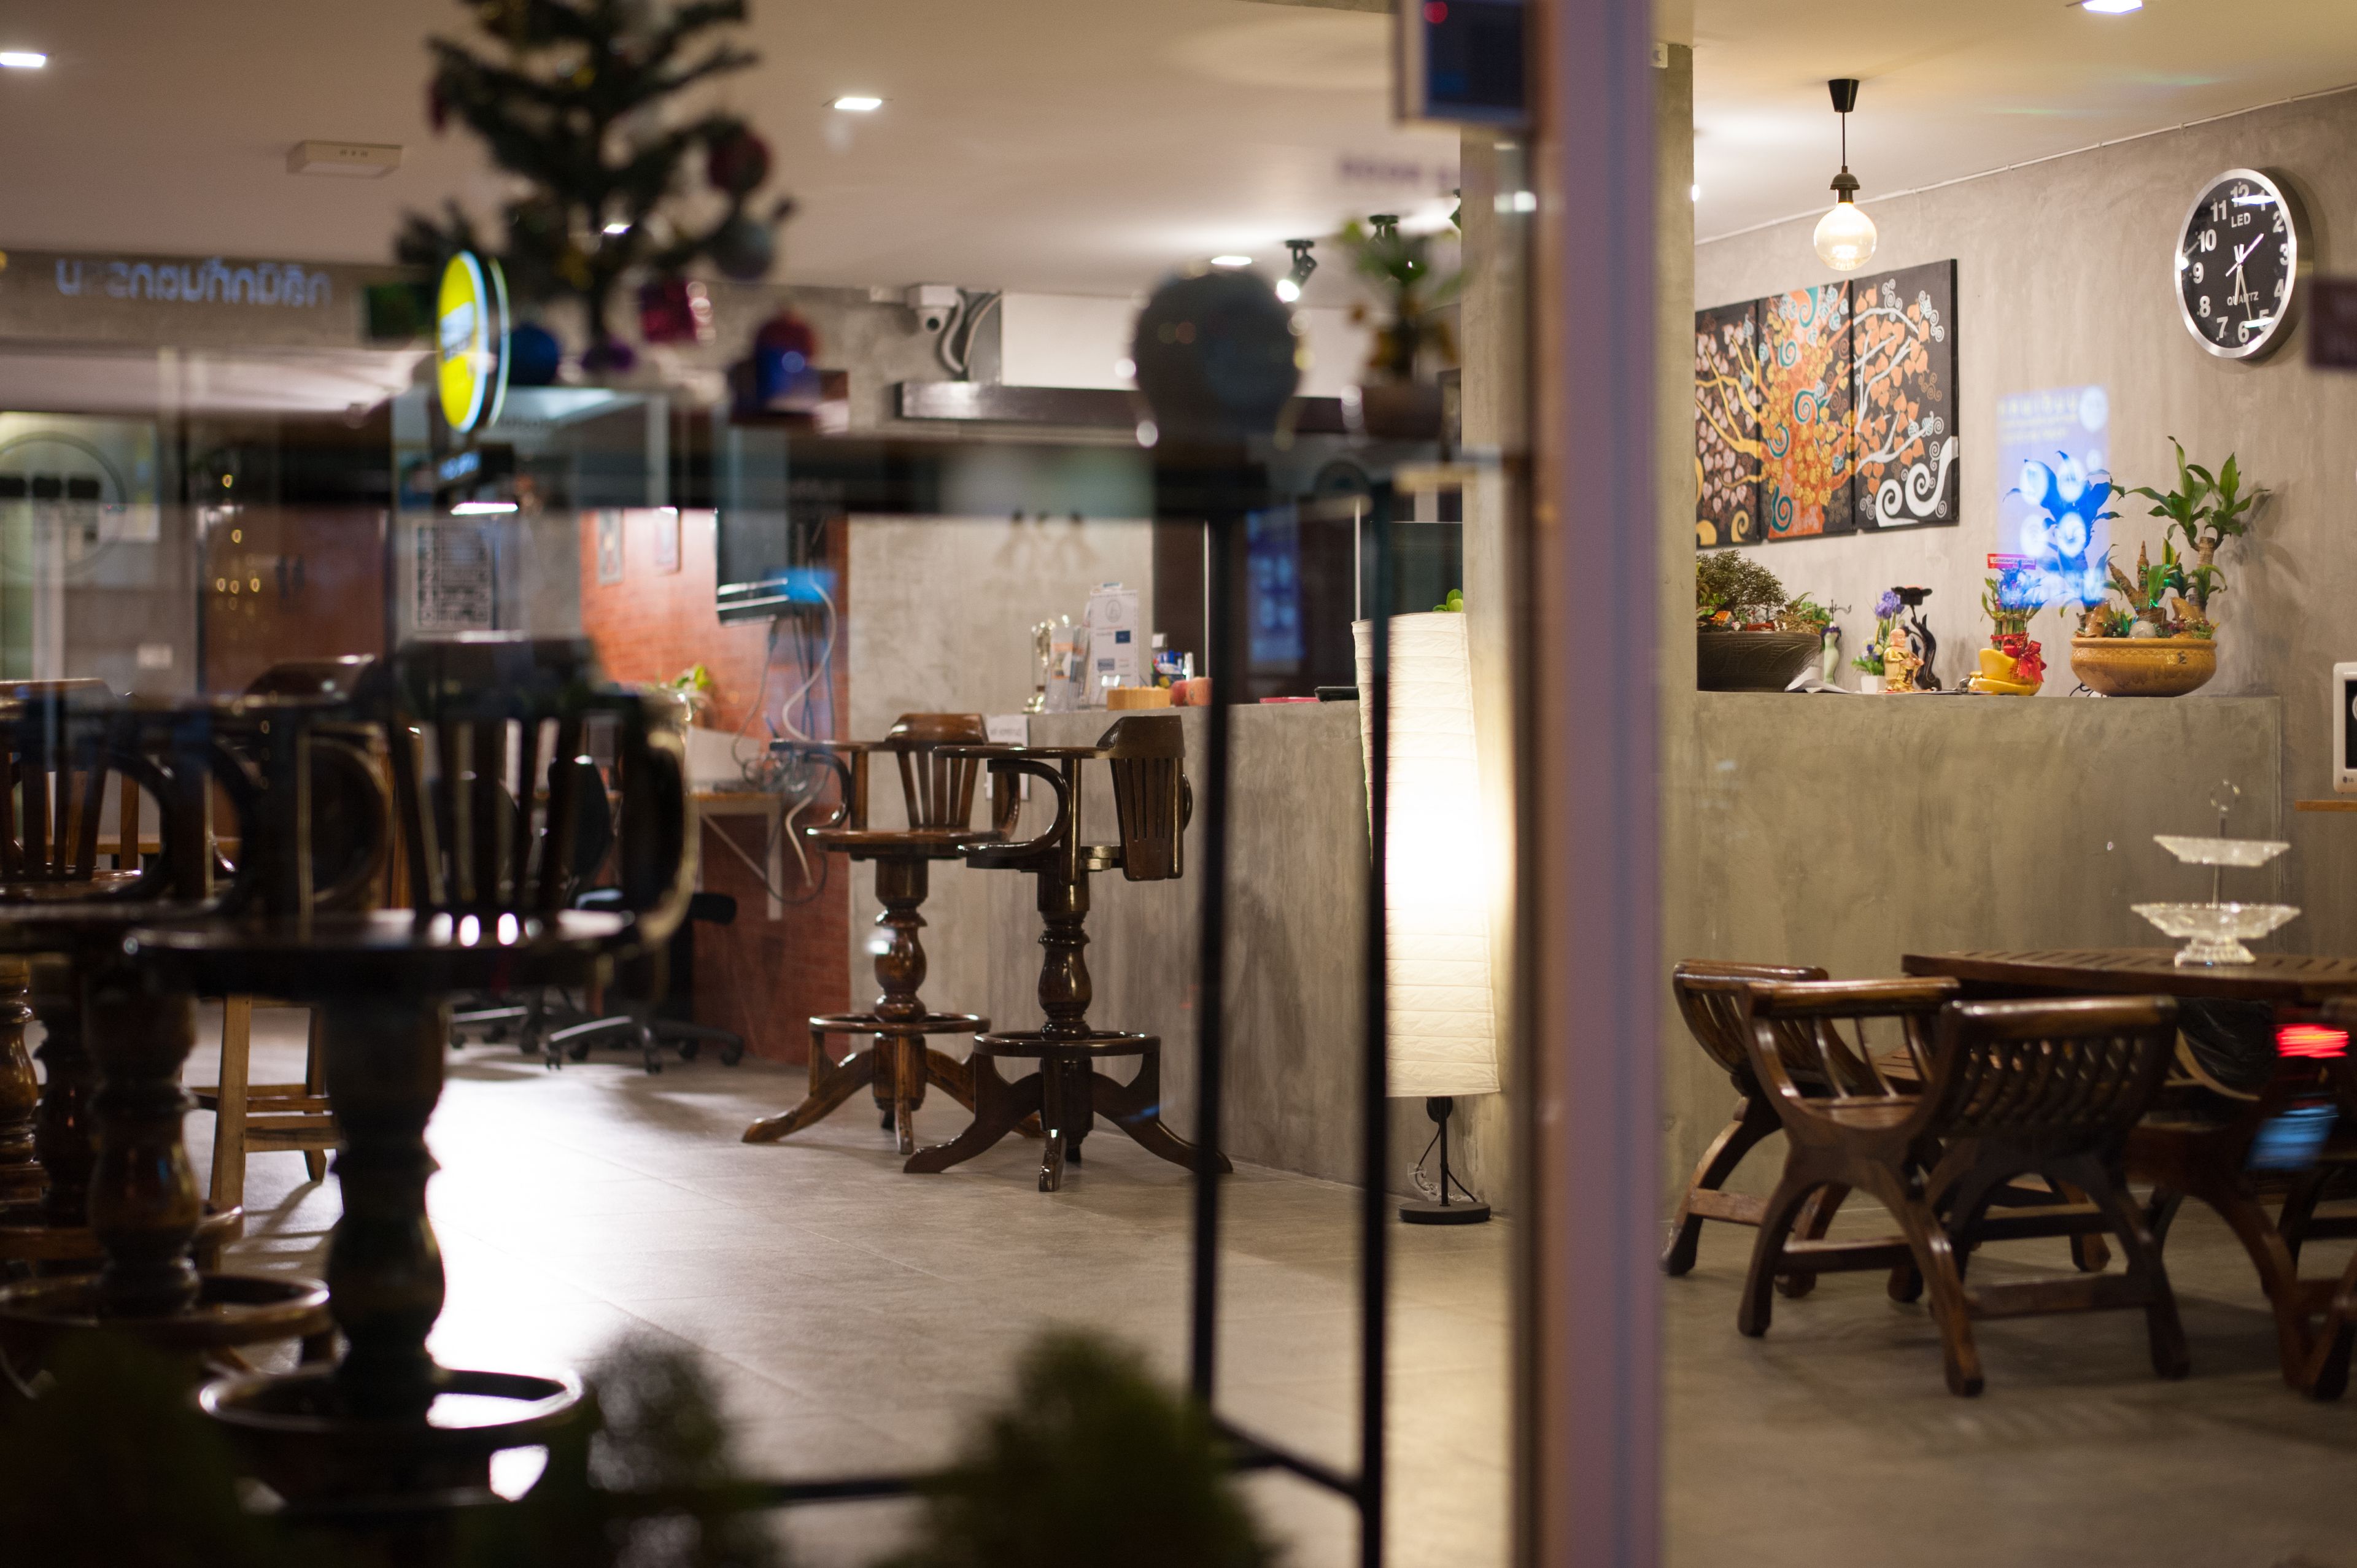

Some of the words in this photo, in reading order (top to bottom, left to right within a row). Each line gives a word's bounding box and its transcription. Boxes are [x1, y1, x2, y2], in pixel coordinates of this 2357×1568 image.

[2230, 184, 2250, 207] 12
[2259, 189, 2266, 211] 1
[2210, 199, 2227, 222] 11
[2231, 212, 2251, 228] LED
[2272, 210, 2285, 233] 2
[2197, 228, 2217, 253] 10
[2279, 243, 2289, 266] 3
[2193, 261, 2204, 284] 9
[2274, 278, 2285, 301] 4
[2199, 295, 2211, 318] 8
[2216, 316, 2229, 339] 7
[2238, 320, 2250, 343] 6
[2259, 309, 2269, 332] 5
